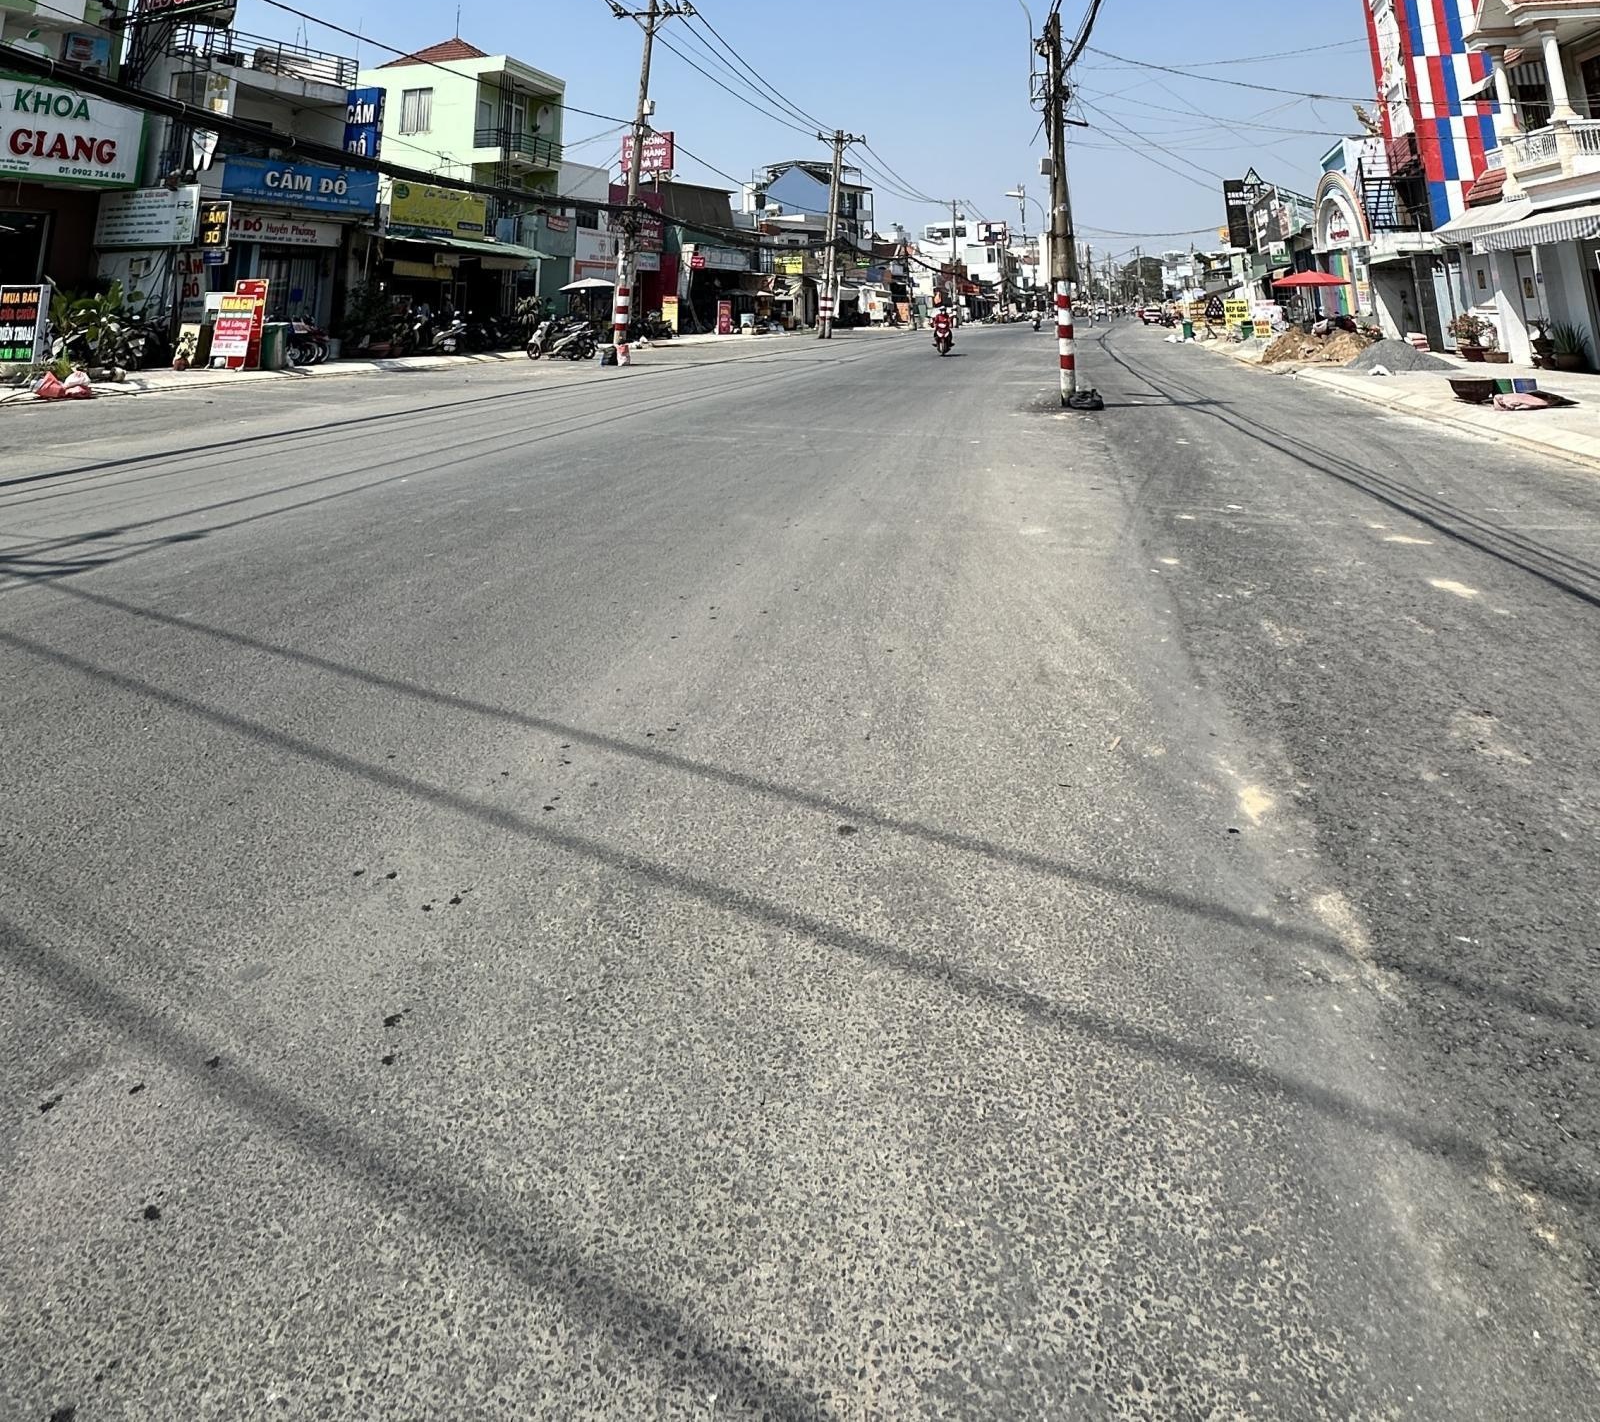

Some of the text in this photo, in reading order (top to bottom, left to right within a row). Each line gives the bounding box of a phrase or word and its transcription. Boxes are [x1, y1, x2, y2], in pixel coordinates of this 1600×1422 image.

[14, 88, 90, 121] KHOA
[9, 128, 117, 164] GIANG
[265, 166, 348, 195] CẦM ĐỒ
[2, 289, 38, 304] MUA BÁN
[221, 297, 254, 310] KHÁCH
